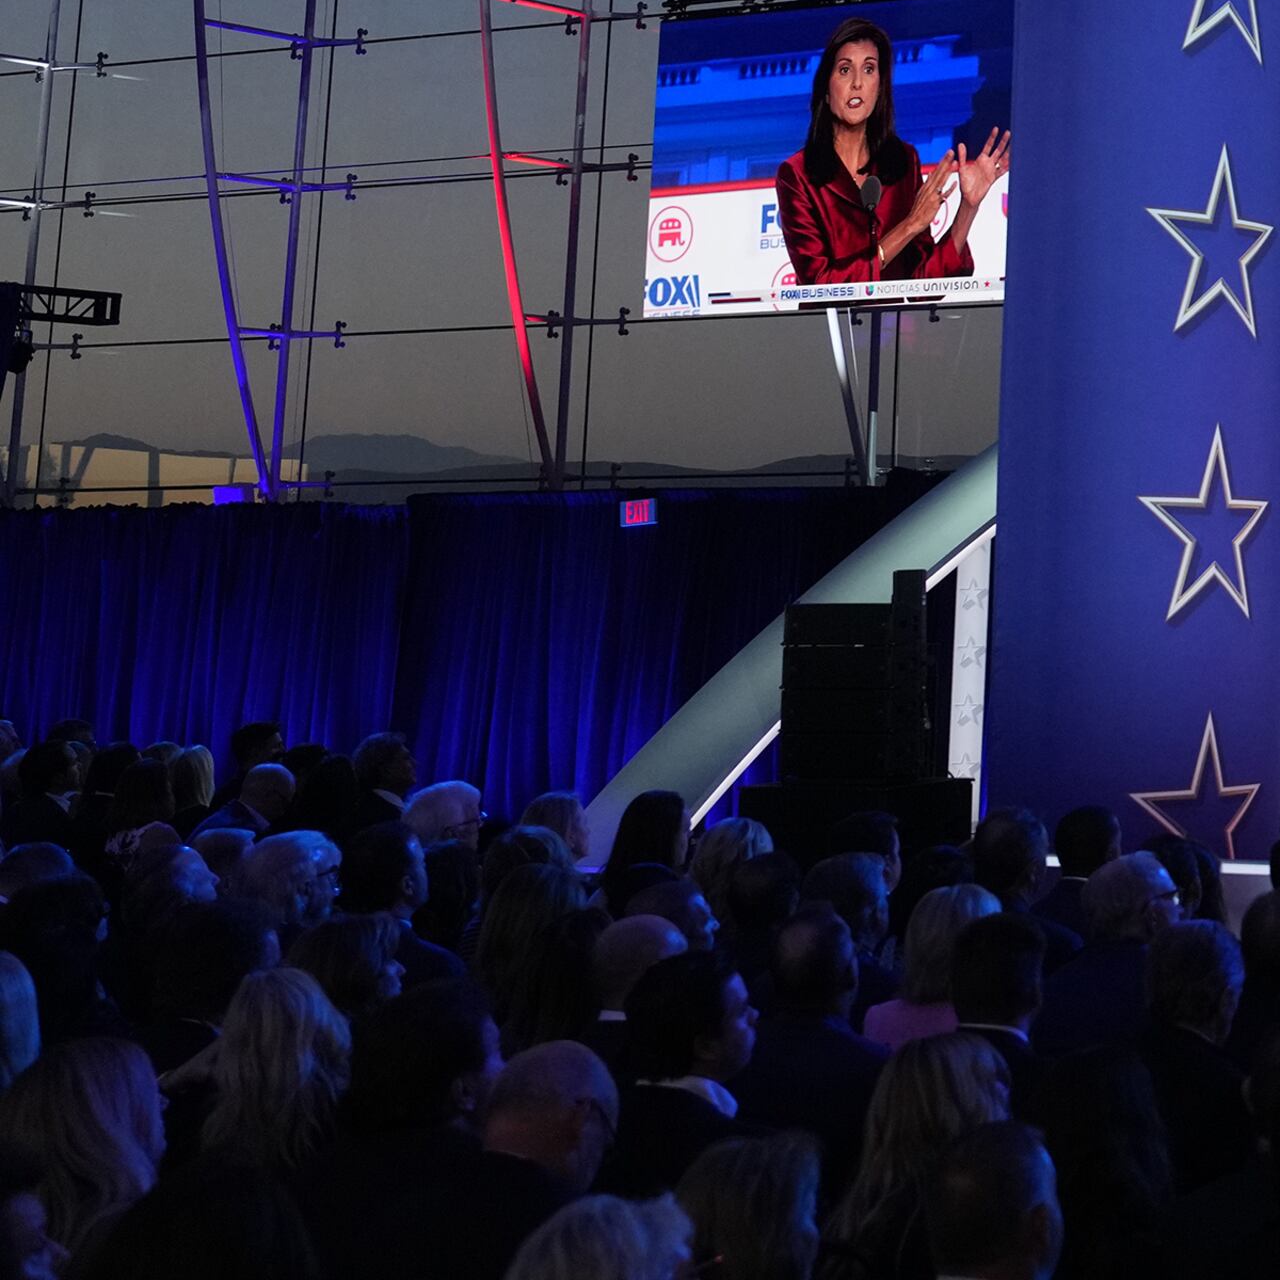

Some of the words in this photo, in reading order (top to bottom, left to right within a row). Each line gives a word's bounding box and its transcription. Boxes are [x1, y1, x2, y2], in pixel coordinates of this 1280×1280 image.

[644, 275, 700, 307] OX
[781, 289, 800, 300] FOX
[802, 286, 855, 299] BUSINESS
[877, 283, 921, 295] NOTICIAS
[626, 499, 649, 524] EXIT
